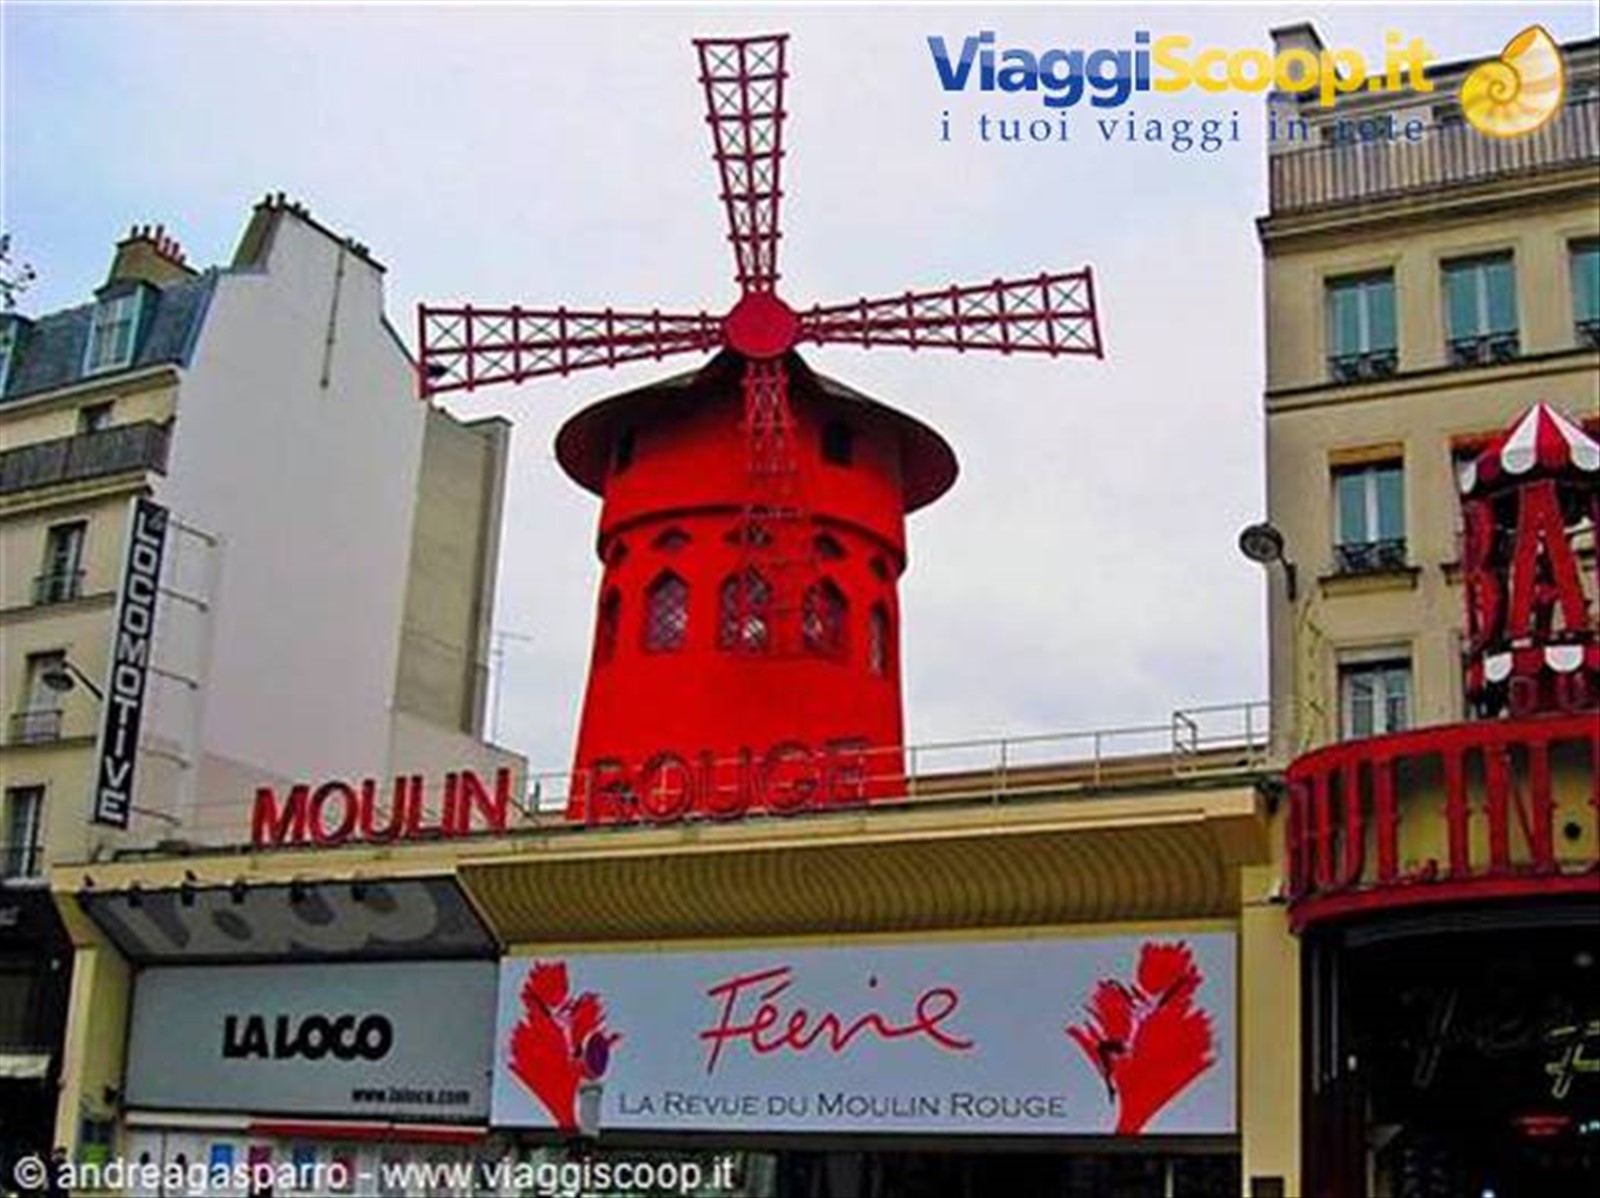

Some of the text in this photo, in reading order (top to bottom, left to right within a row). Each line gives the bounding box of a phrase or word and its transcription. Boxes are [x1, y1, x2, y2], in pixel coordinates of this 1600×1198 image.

[1462, 479, 1600, 648] BA
[100, 511, 161, 823] LOCOMOTIVE
[251, 738, 868, 850] MOULIN ROUGE
[223, 1013, 394, 1061] LA LOCO
[817, 1091, 941, 1119] MOULIN
[950, 1091, 1067, 1120] ROUGE
